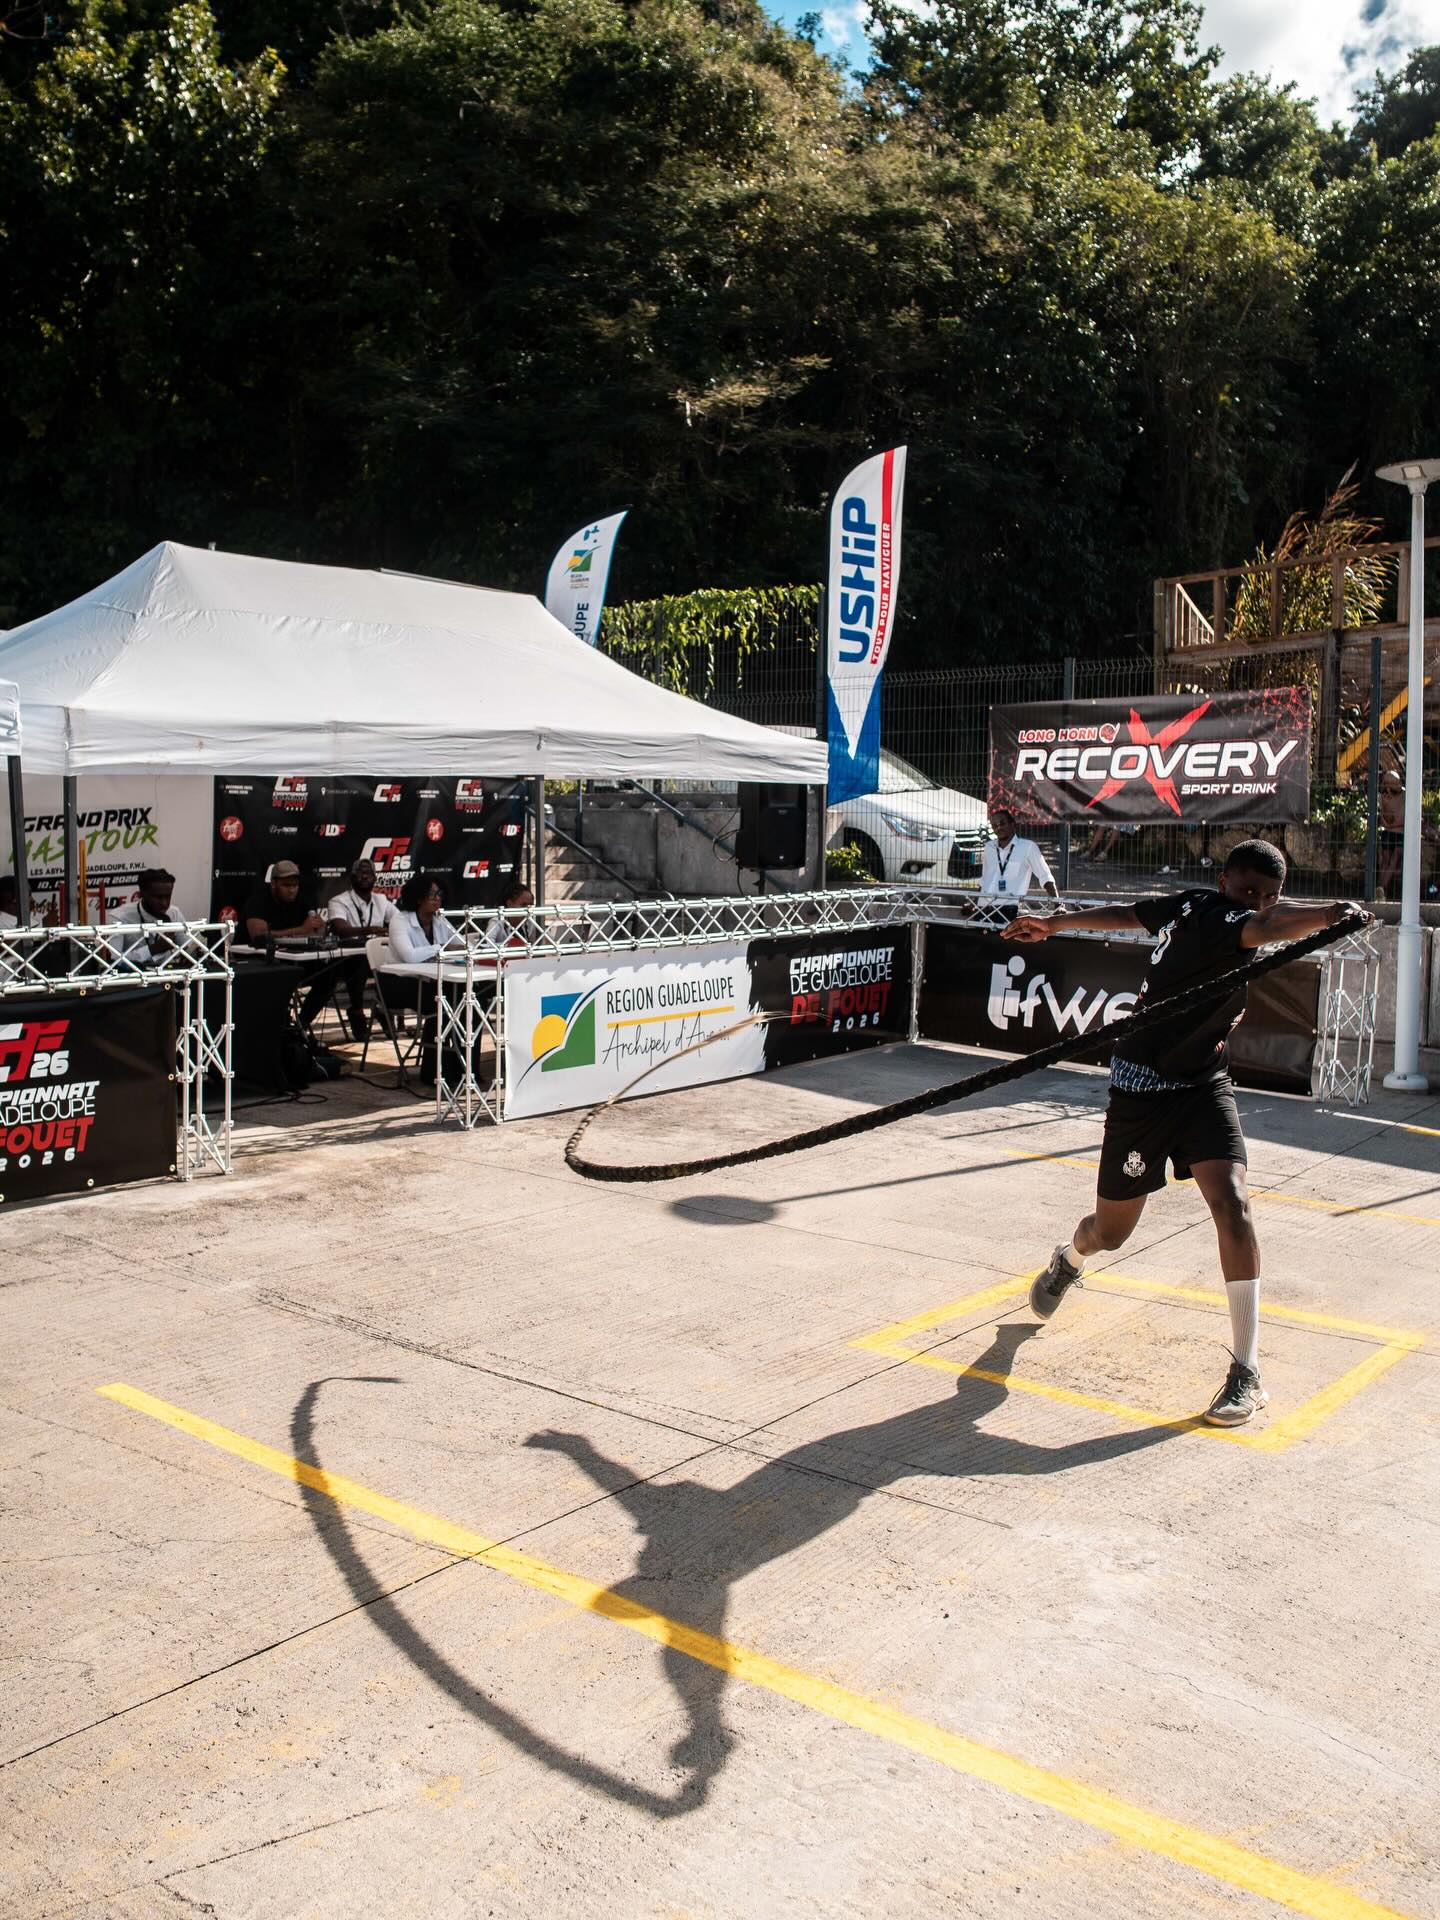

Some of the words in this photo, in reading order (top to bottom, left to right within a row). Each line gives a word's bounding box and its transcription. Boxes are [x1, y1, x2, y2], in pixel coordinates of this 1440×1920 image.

[882, 523, 891, 589] NAVIGUER
[880, 595, 889, 626] POUR
[872, 631, 884, 661] TOUT
[1019, 729, 1055, 742] LONG
[1058, 727, 1098, 741] HORN
[1014, 740, 1298, 781] RECOVERY
[1181, 784, 1230, 795] SPORT
[1232, 783, 1276, 794] DRINK
[103, 807, 152, 831] PRIX
[85, 824, 159, 856] TOUR
[391, 856, 411, 870] 26
[112, 876, 139, 884] 2026
[790, 947, 894, 974] CHAMPIONNAT
[790, 973, 808, 994] DE
[811, 962, 893, 991] GUADELOUPE
[607, 986, 653, 1014] REGION
[658, 976, 734, 1008] GUADELOUPE
[790, 992, 820, 1025] DE
[826, 982, 891, 1026] FOUET
[832, 1012, 879, 1032] 2026
[602, 1023, 671, 1072] Archipel
[30, 1050, 69, 1078] 26
